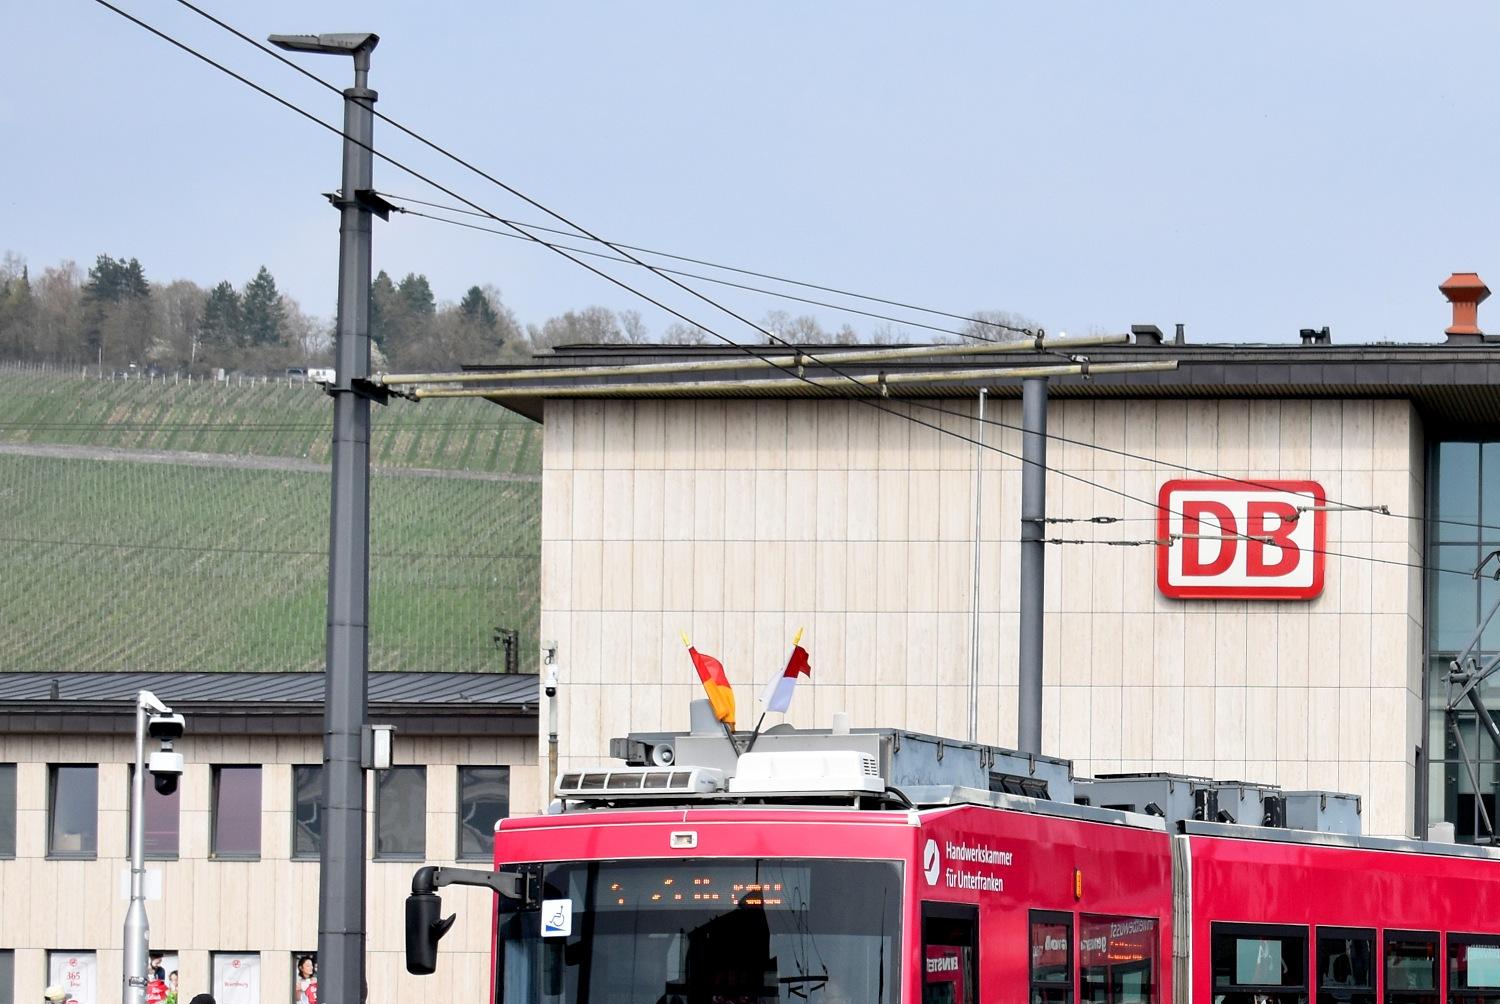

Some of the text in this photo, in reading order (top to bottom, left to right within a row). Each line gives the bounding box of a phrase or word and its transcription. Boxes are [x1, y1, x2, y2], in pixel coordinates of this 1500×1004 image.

[1182, 500, 1300, 577] DB
[946, 841, 1012, 866] Handwerkskammer
[946, 868, 1003, 892] für Unterfranken
